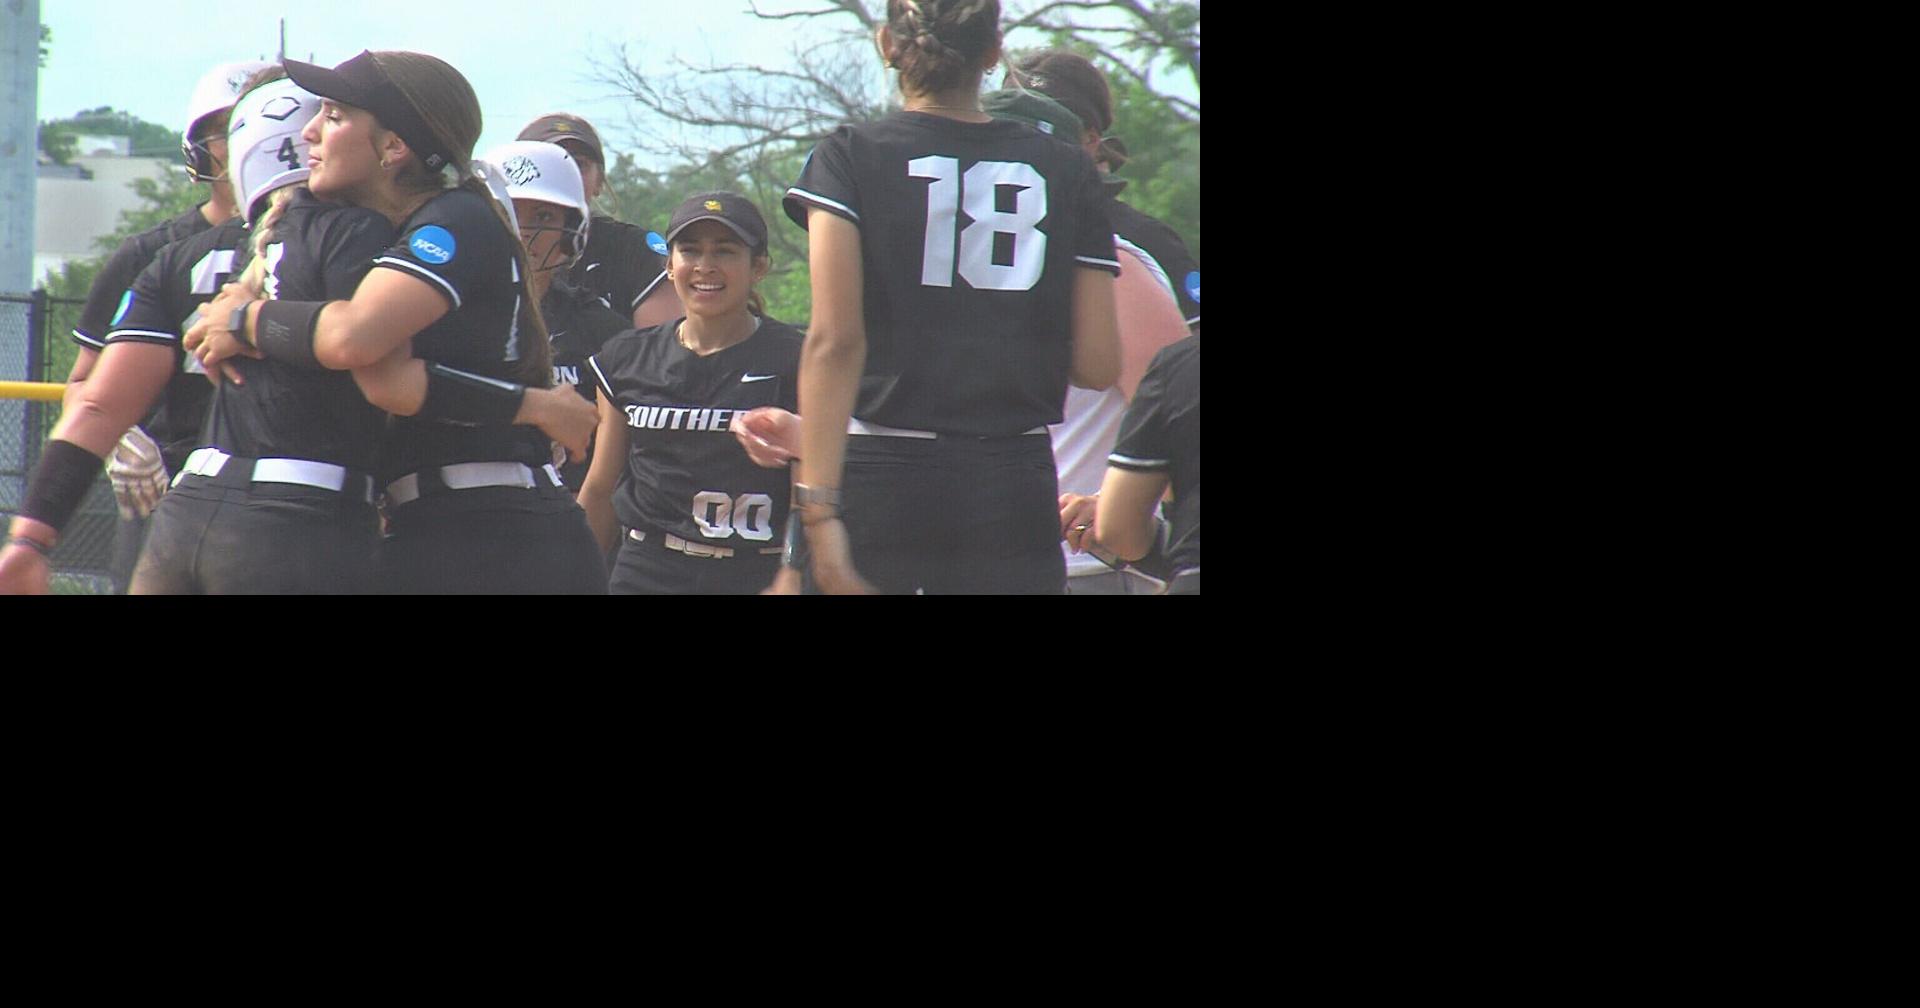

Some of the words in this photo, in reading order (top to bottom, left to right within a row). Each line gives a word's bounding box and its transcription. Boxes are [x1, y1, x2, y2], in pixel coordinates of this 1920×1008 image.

[277, 136, 301, 170] 4
[908, 155, 1047, 291] 18
[412, 238, 450, 261] NCAA
[692, 490, 773, 541] 00
